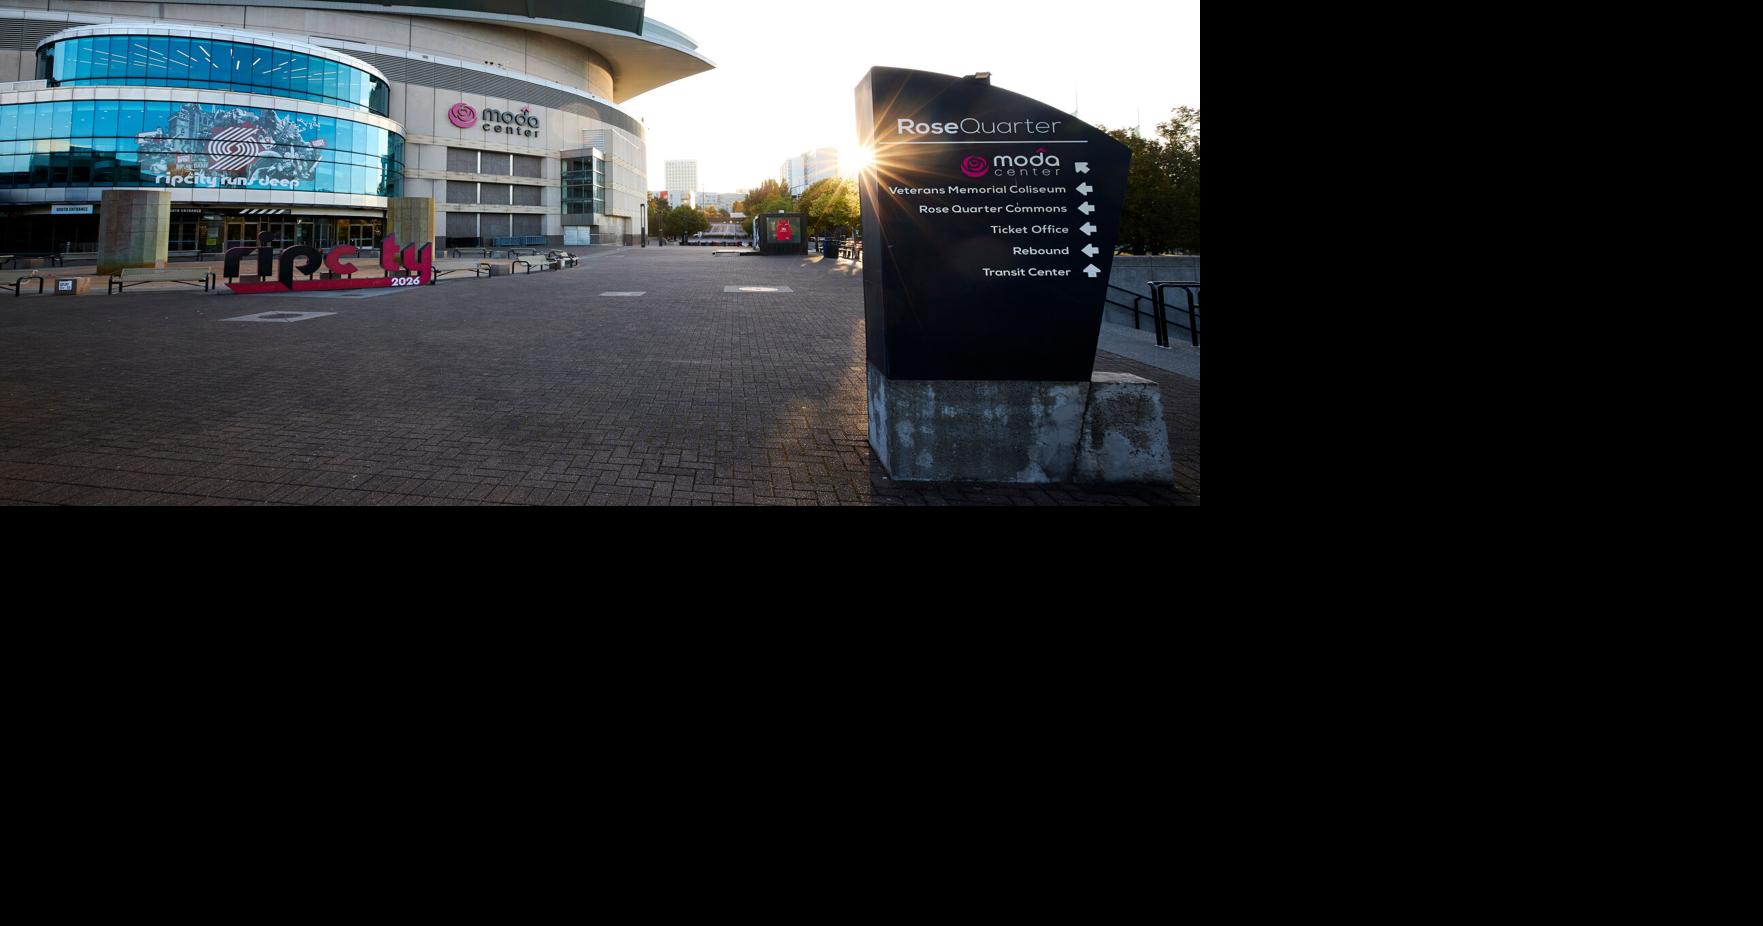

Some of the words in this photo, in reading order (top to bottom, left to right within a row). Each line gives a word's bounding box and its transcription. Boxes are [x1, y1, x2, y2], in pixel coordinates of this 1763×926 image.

[482, 106, 539, 128] moda
[482, 123, 539, 138] center
[993, 148, 1060, 167] moda
[994, 167, 1061, 176] center
[258, 174, 300, 189] deep
[889, 186, 946, 195] Veterans
[948, 185, 1007, 194] Memorial
[1009, 185, 1067, 194] Coliseum
[919, 205, 950, 214] Rose
[951, 204, 1003, 214] Quarter
[1005, 204, 1068, 213] Commons
[990, 225, 1028, 234] Ticket
[1031, 225, 1069, 234] Office
[1012, 246, 1070, 255] Rebound
[982, 267, 1026, 277] Transit
[1028, 267, 1072, 277] Center
[391, 276, 420, 287] 2026
